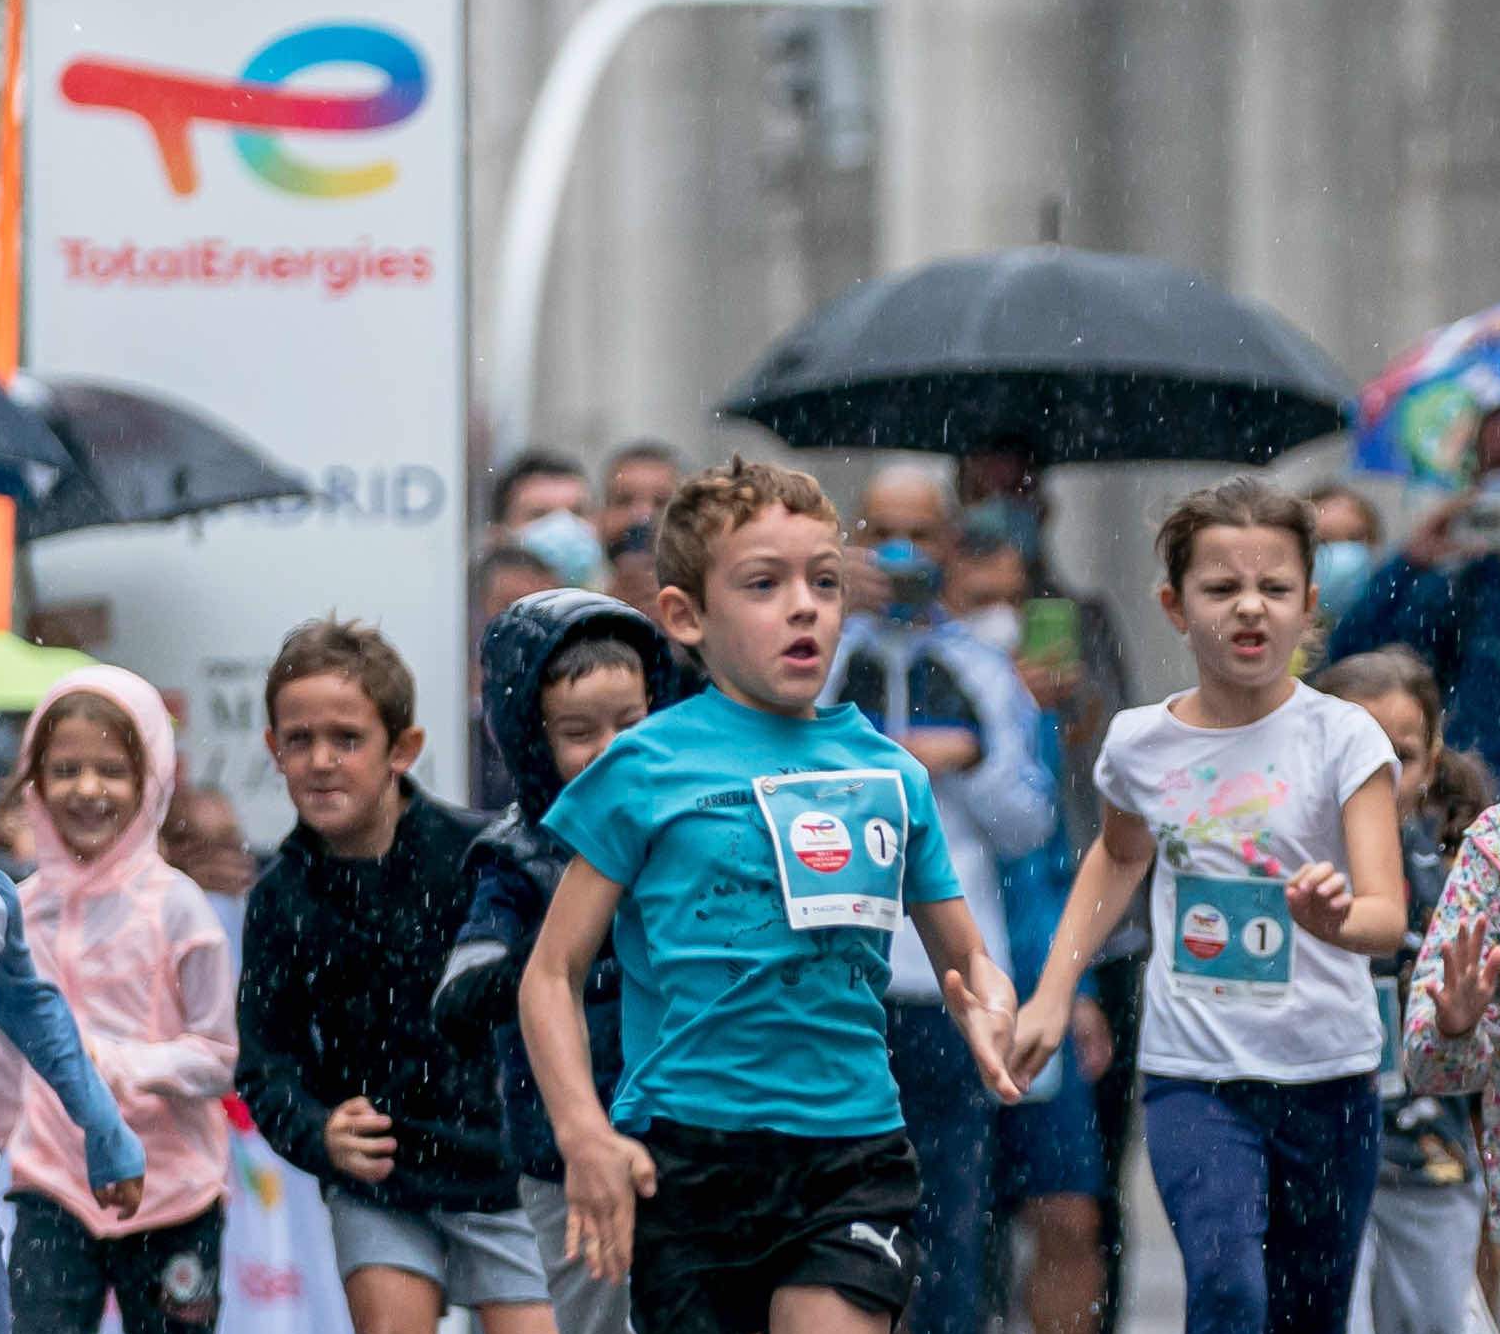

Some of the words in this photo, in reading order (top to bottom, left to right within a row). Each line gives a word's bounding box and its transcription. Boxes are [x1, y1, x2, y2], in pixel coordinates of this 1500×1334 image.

[61, 236, 434, 294] TotalEnergies
[873, 824, 887, 860] 1
[1255, 921, 1268, 952] 1
